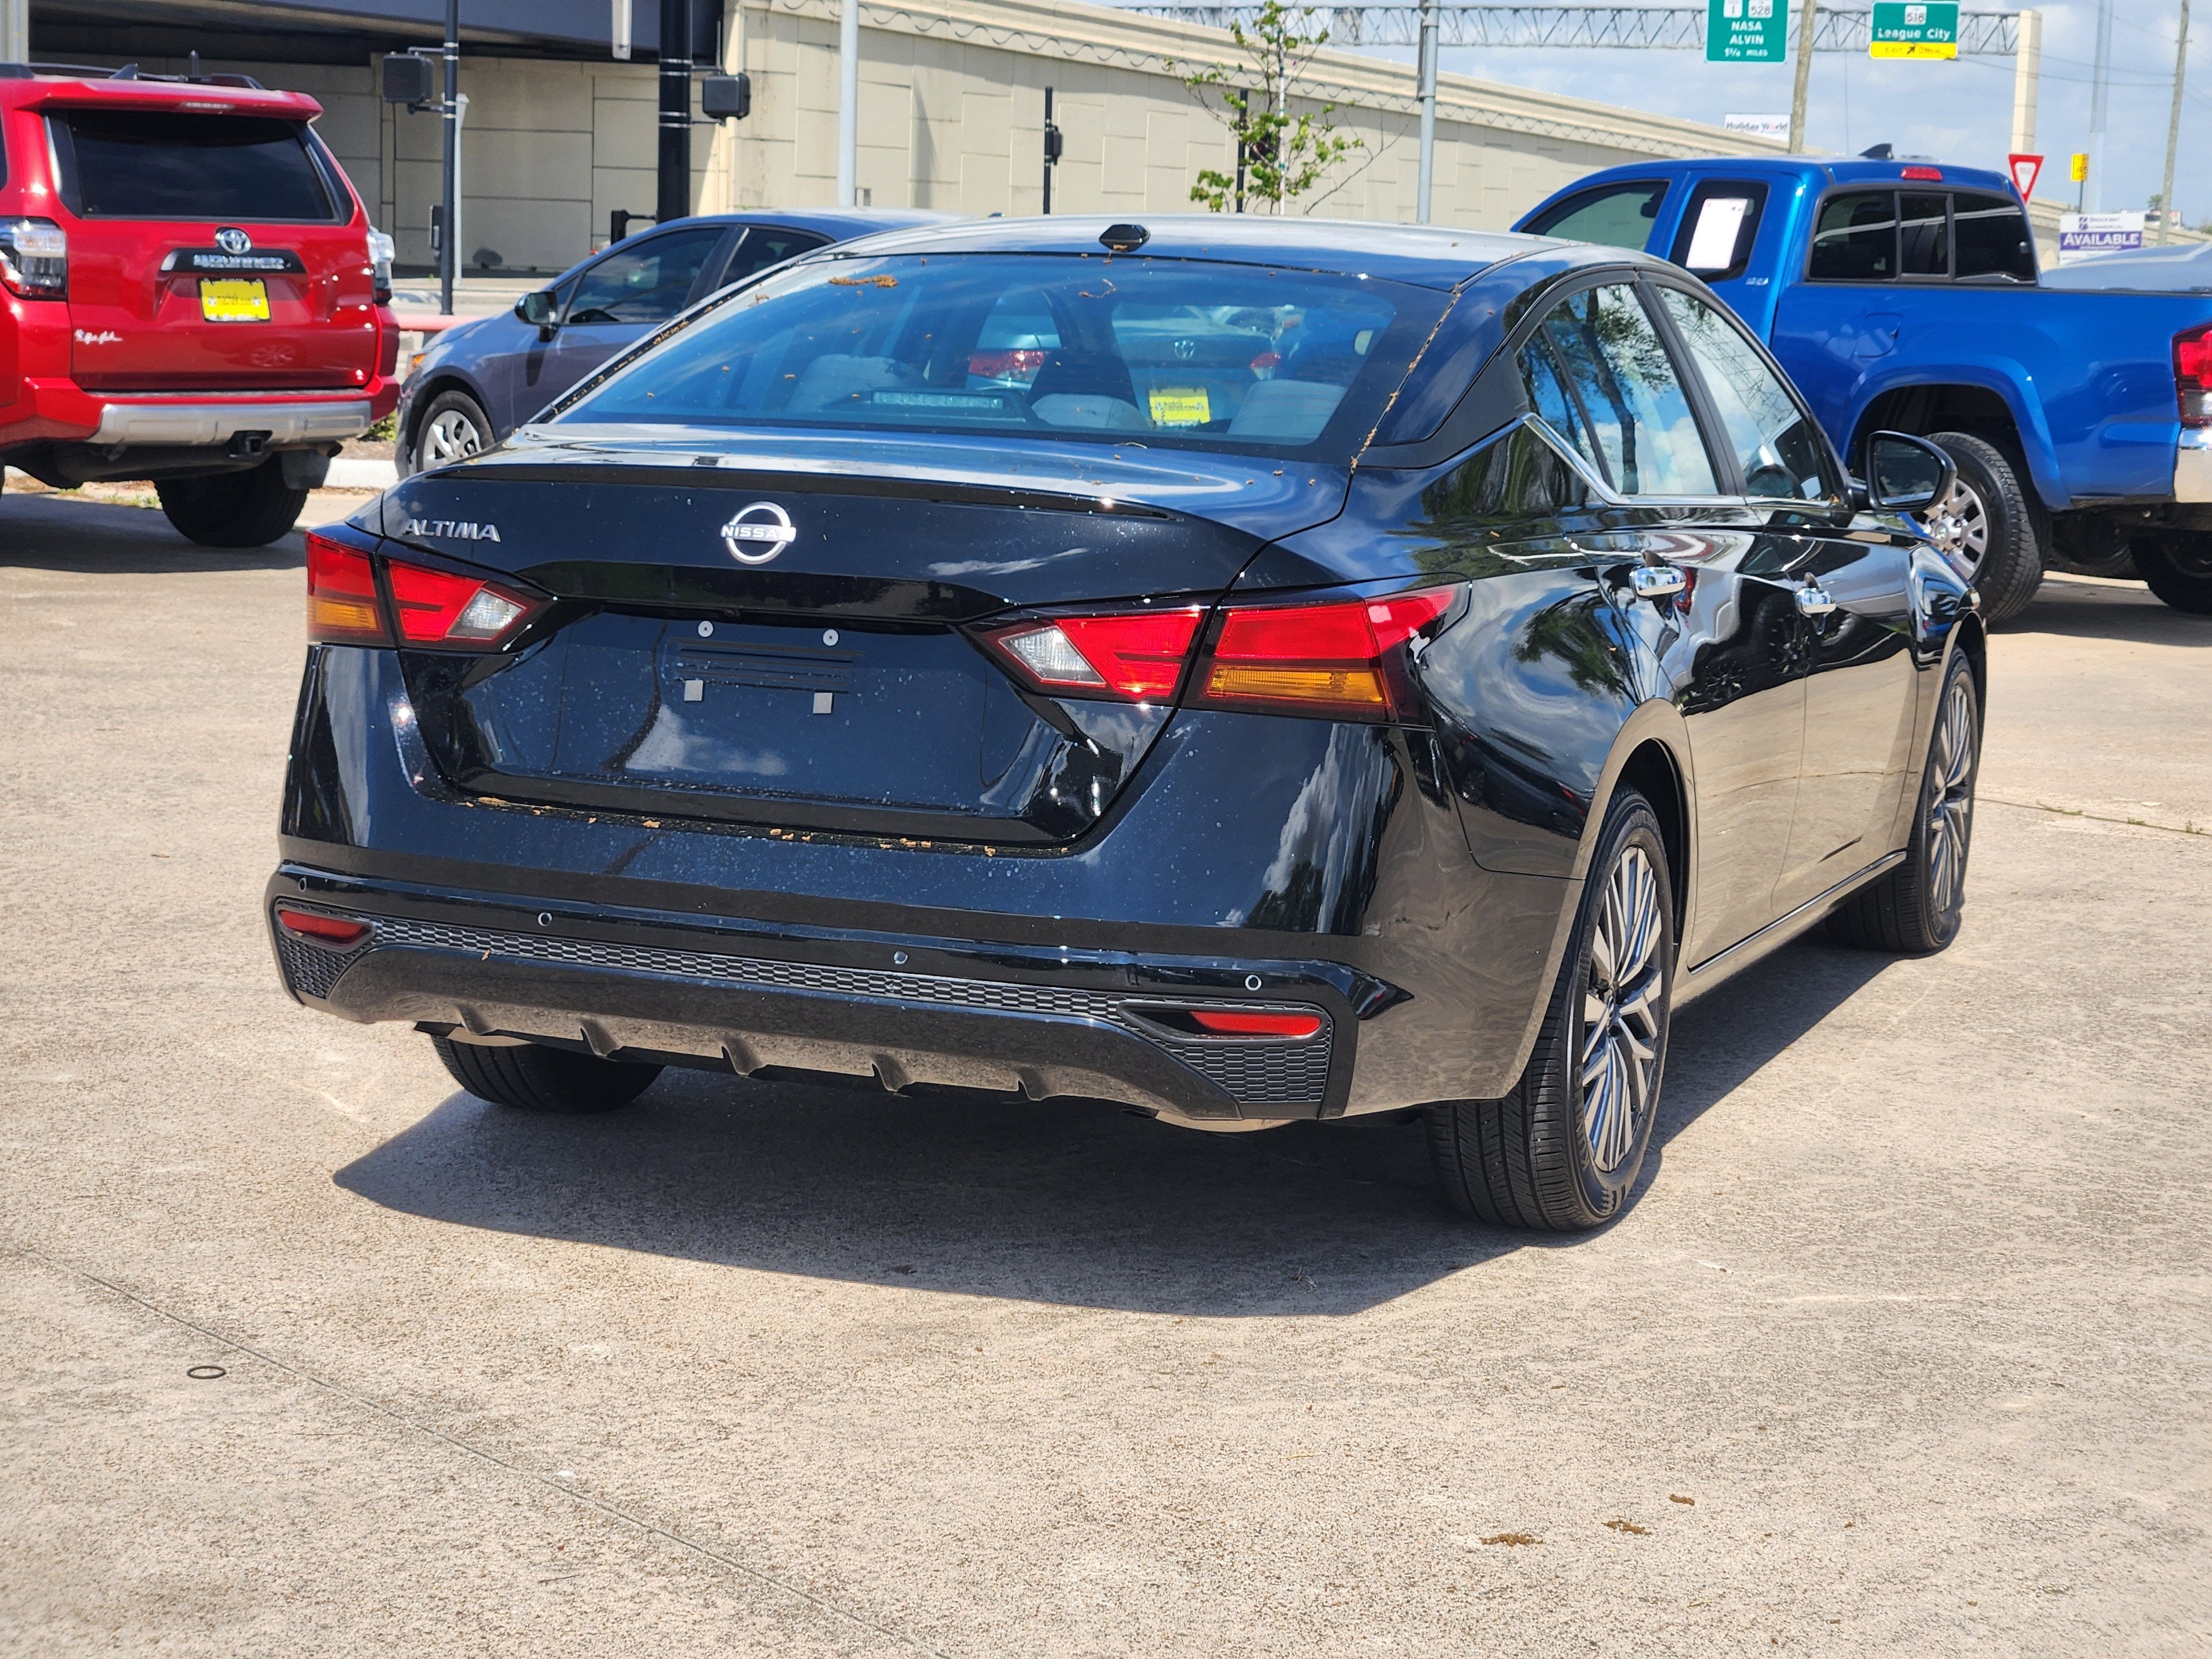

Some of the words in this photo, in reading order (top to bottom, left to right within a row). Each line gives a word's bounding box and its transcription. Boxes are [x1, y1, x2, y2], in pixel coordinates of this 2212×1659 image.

[1751, 6, 1770, 15] 528
[1907, 12, 1924, 22] 518
[1731, 21, 1763, 32] NASA
[1729, 34, 1764, 45] ALVIN
[1877, 28, 1921, 40] League
[1927, 28, 1950, 41] City
[2063, 233, 2140, 246] AVAILABLE
[402, 518, 501, 542] ALTIMA
[720, 525, 793, 540] NISSA
